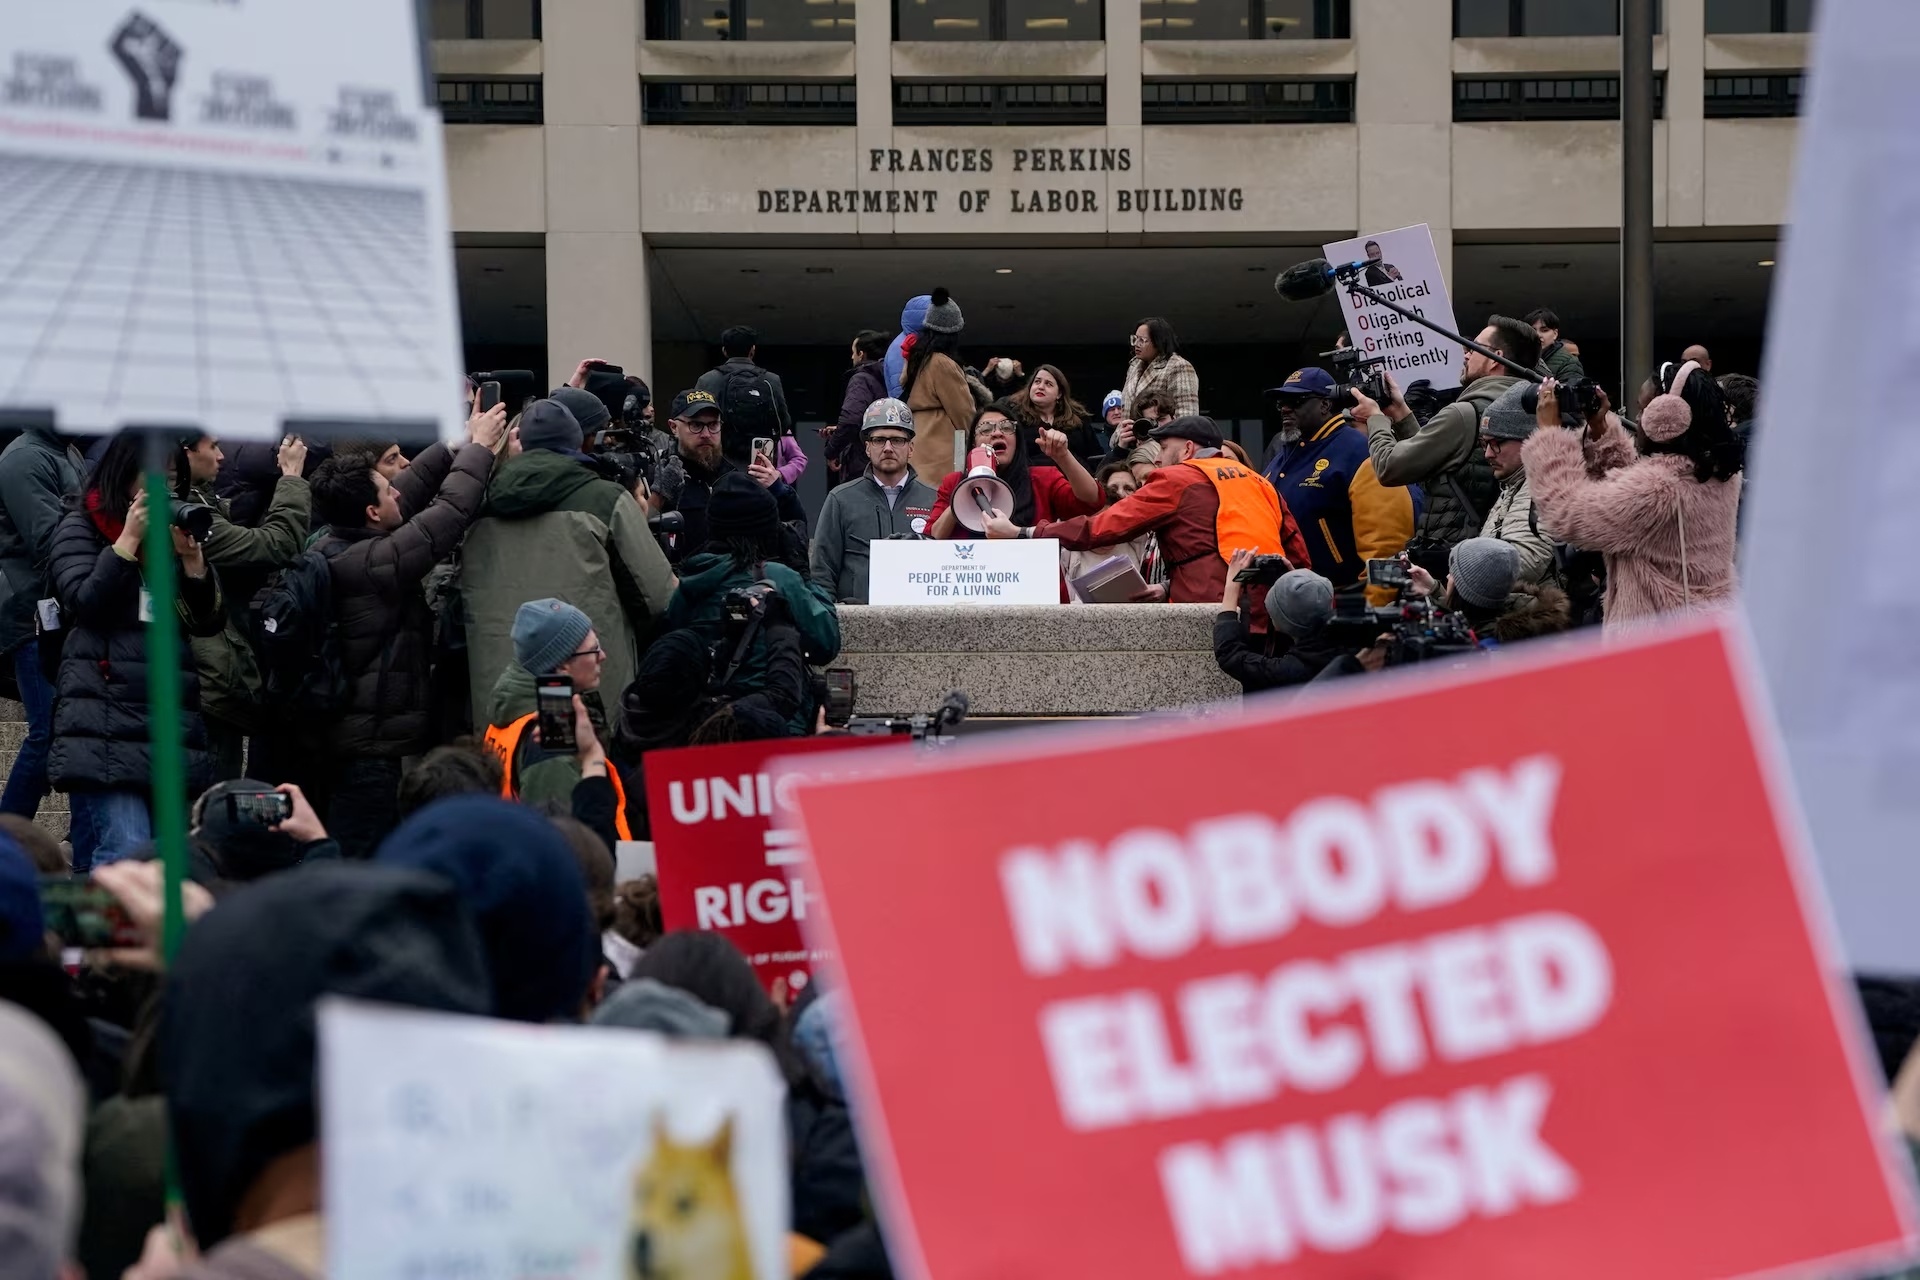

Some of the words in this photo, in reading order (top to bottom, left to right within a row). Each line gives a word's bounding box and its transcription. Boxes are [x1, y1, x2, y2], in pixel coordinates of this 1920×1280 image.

[869, 148, 993, 172] FRANCES
[1012, 148, 1131, 171] PERKINS
[757, 190, 938, 214] DEPARTMENT
[959, 189, 990, 213] OF
[1010, 188, 1098, 213] LABOR
[1117, 187, 1244, 212] BUILDING
[1364, 331, 1425, 352] Grifting
[908, 572, 952, 583] PEOPLE
[956, 572, 982, 583] WHO
[986, 572, 1020, 583] WORK
[927, 585, 948, 596] FOR
[953, 585, 960, 596] A
[964, 585, 1001, 596] LIVING
[1002, 754, 1560, 975] NOBODY
[1039, 911, 1612, 1131] ELECTED
[1159, 1074, 1578, 1273] MUSK
